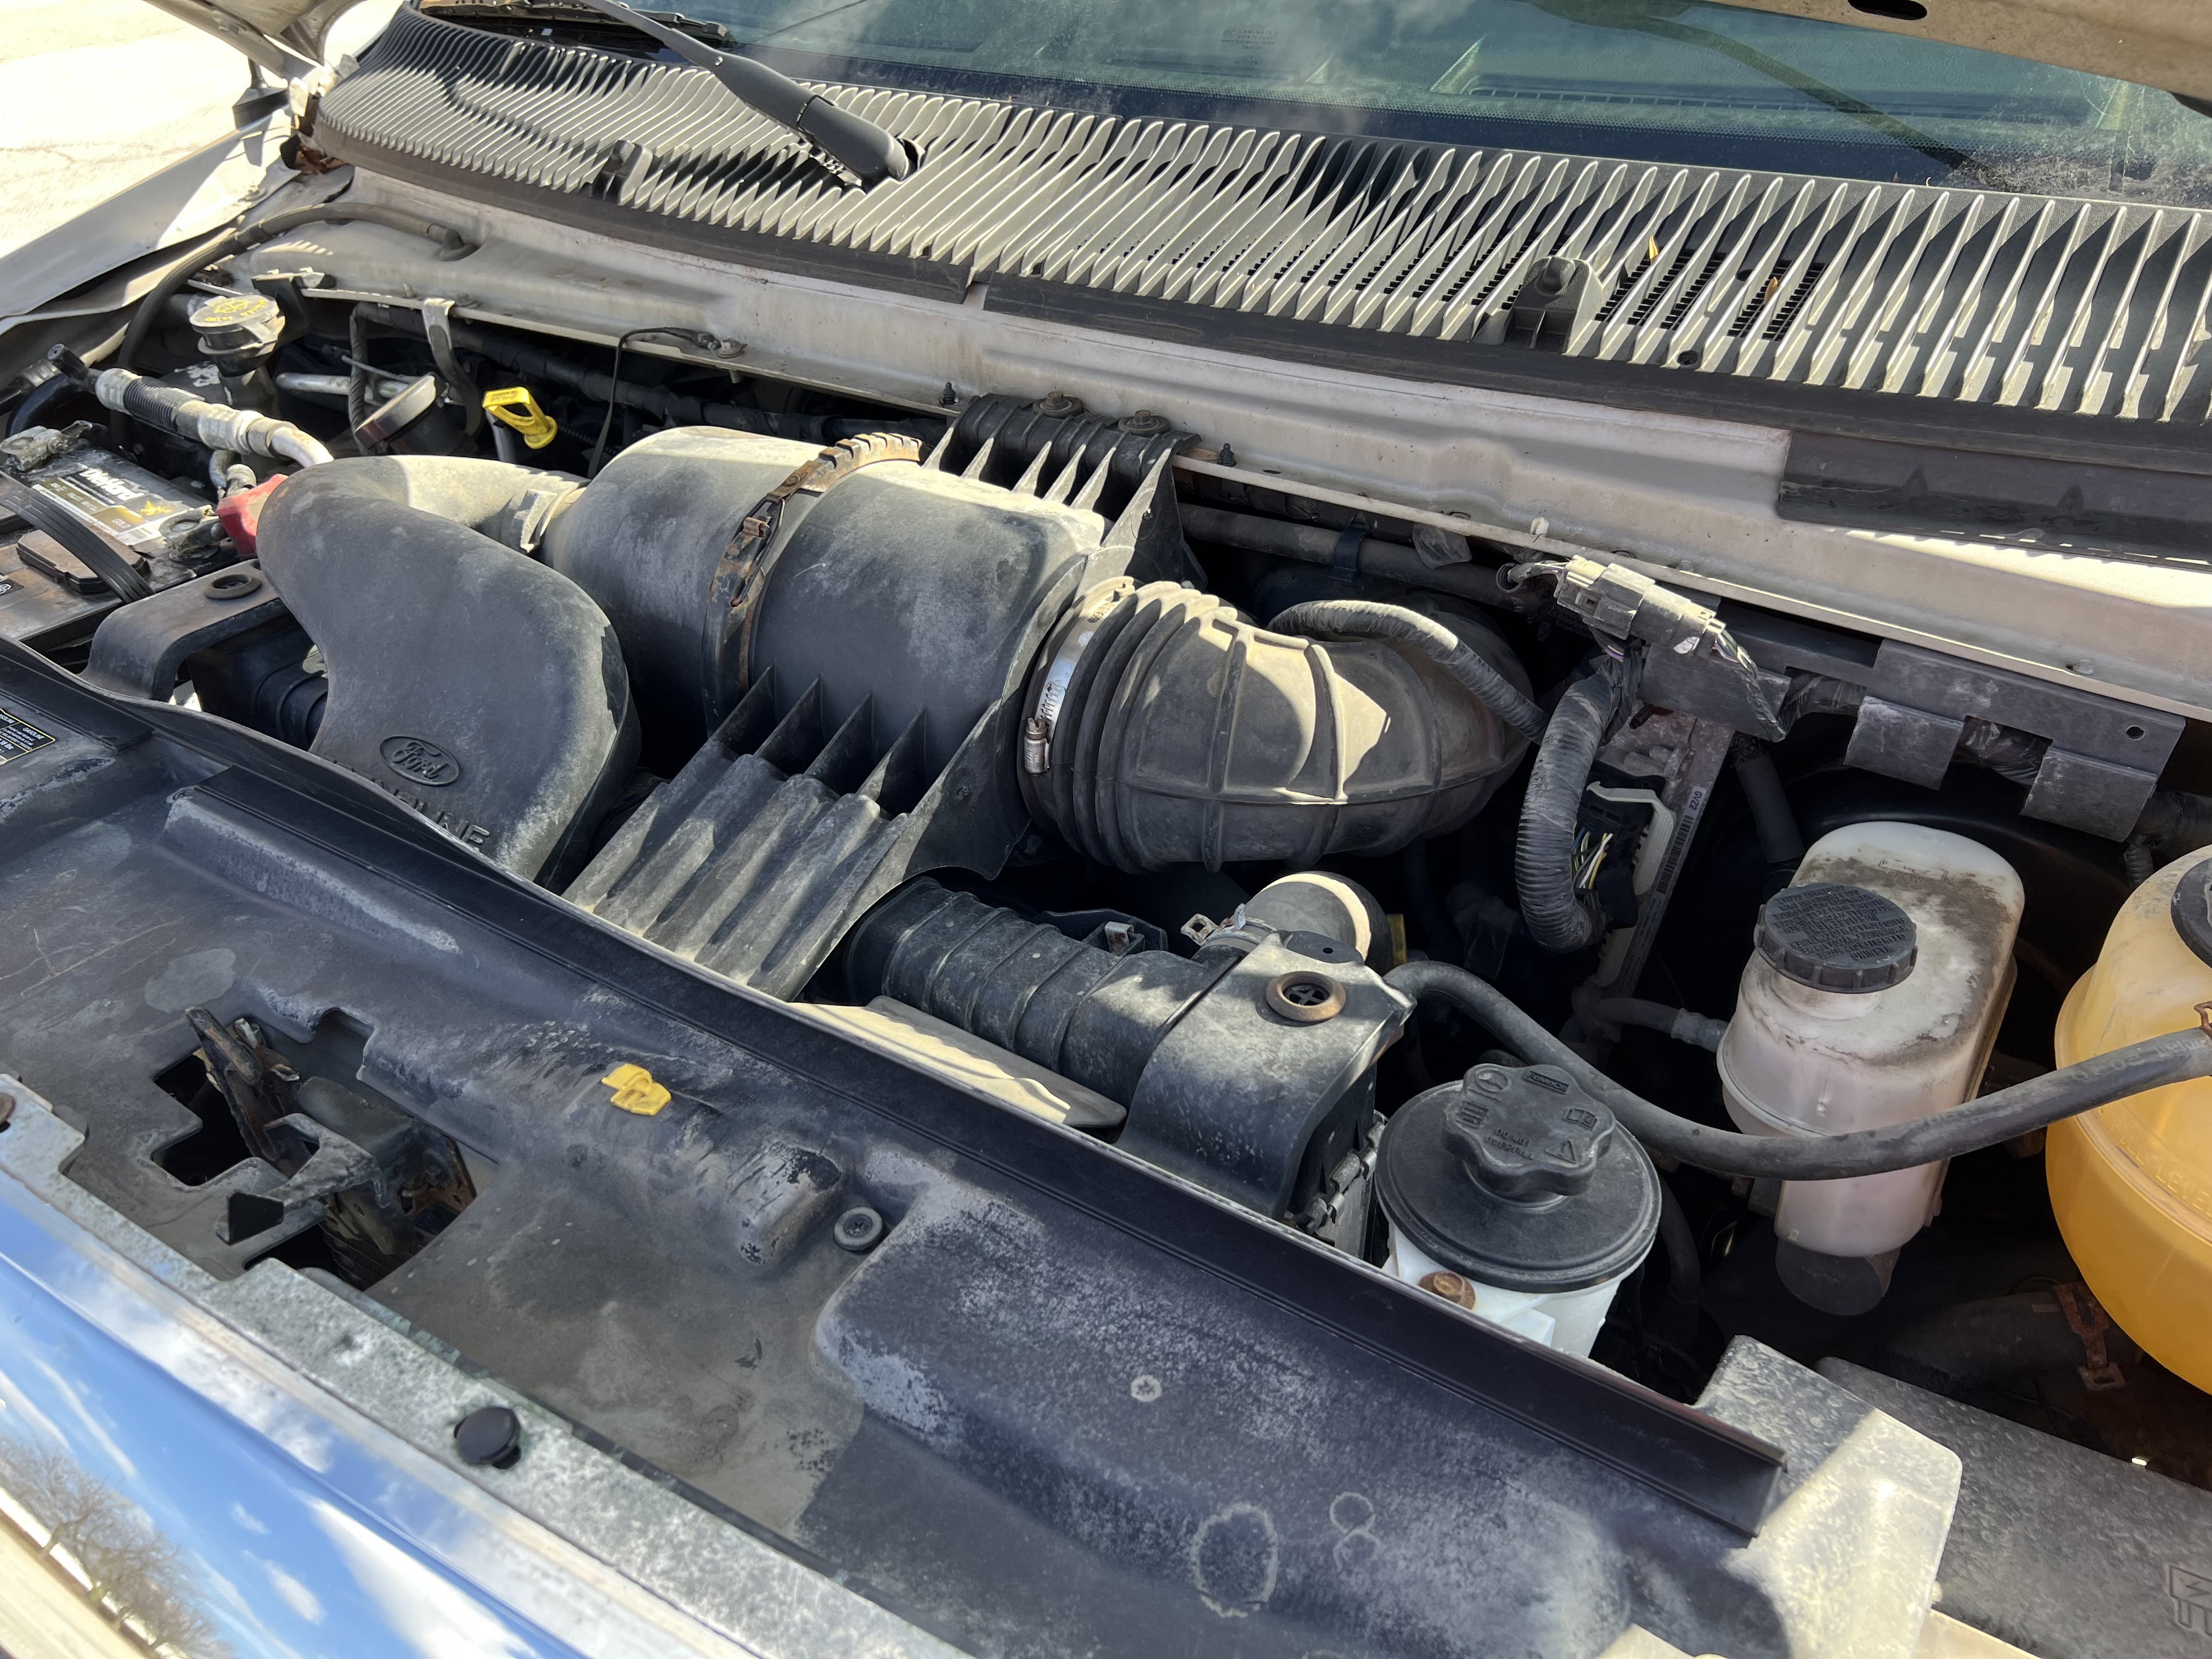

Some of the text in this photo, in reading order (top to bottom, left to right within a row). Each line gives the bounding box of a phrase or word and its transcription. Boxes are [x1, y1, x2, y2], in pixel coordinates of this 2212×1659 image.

[78, 468, 145, 501] DieHard
[392, 741, 450, 779] Ford
[1528, 1072, 1567, 1092] FoMoCo
